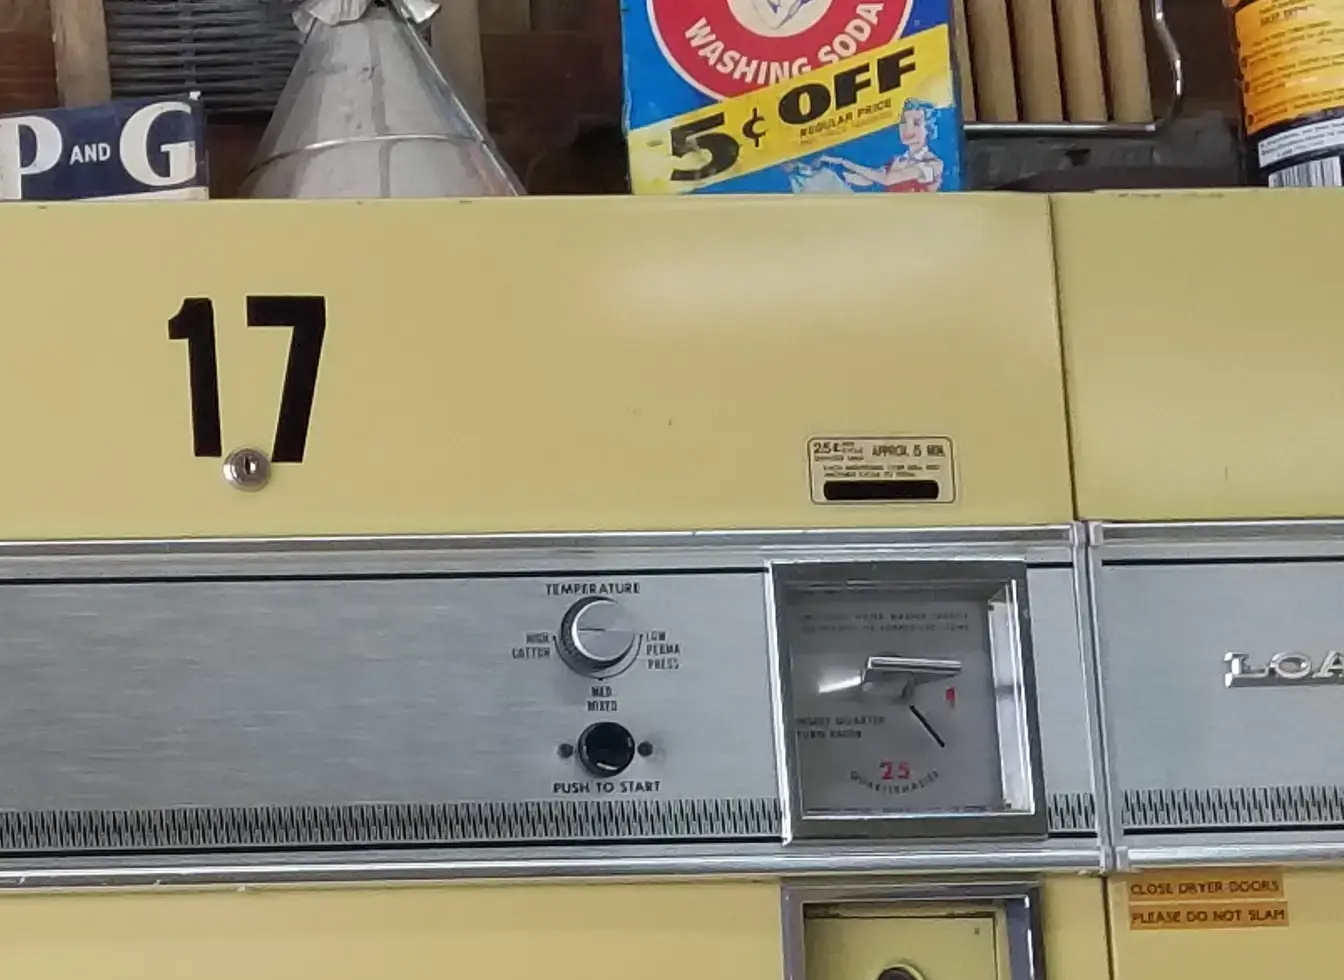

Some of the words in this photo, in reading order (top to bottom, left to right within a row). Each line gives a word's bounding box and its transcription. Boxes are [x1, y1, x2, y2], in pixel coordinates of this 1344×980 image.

[684, 17, 812, 84] WASHING
[818, 2, 884, 66] SODA
[778, 46, 916, 124] OFF
[69, 143, 111, 165] AND
[119, 101, 197, 186] G
[168, 295, 327, 464] 17
[913, 444, 923, 457] 5
[546, 582, 641, 596] TEMPERATURE
[553, 781, 590, 794] PUSH
[595, 781, 615, 793] TO
[620, 780, 661, 793] START
[1130, 882, 1173, 895] CLOSE
[1178, 881, 1224, 894] DRYER
[1229, 879, 1280, 892] DOORS
[1132, 911, 1181, 924] PLEASE
[1186, 910, 1208, 923] DO
[1213, 910, 1242, 922] NOT
[1248, 908, 1285, 921] SLAM
